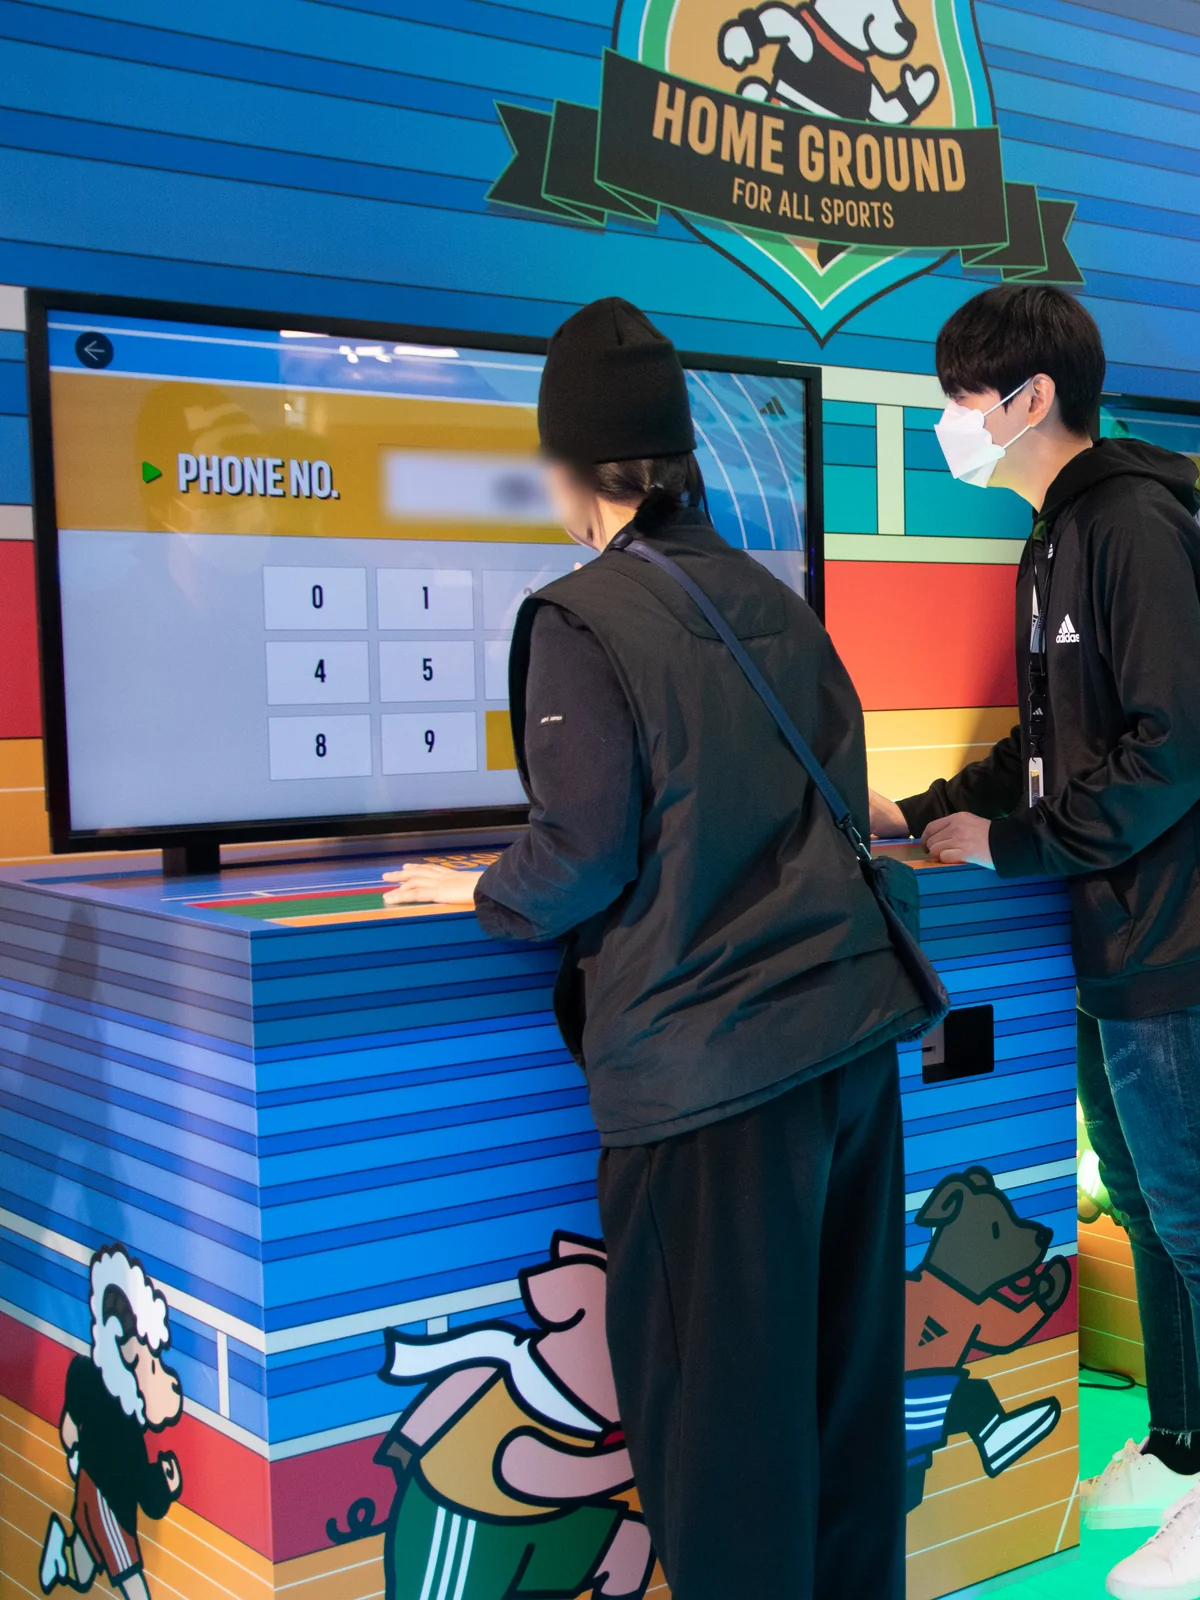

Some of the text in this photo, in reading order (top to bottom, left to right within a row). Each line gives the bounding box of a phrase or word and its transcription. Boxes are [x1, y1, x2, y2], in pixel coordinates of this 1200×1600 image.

[652, 80, 966, 192] HOME GROUND
[732, 177, 894, 229] FOR ALL SPORTS
[177, 452, 341, 500] PHONE NO.
[312, 584, 429, 610] 0 1
[1055, 632, 1080, 644] adidas
[314, 658, 433, 683] 4 5
[315, 729, 435, 758] 8 9
